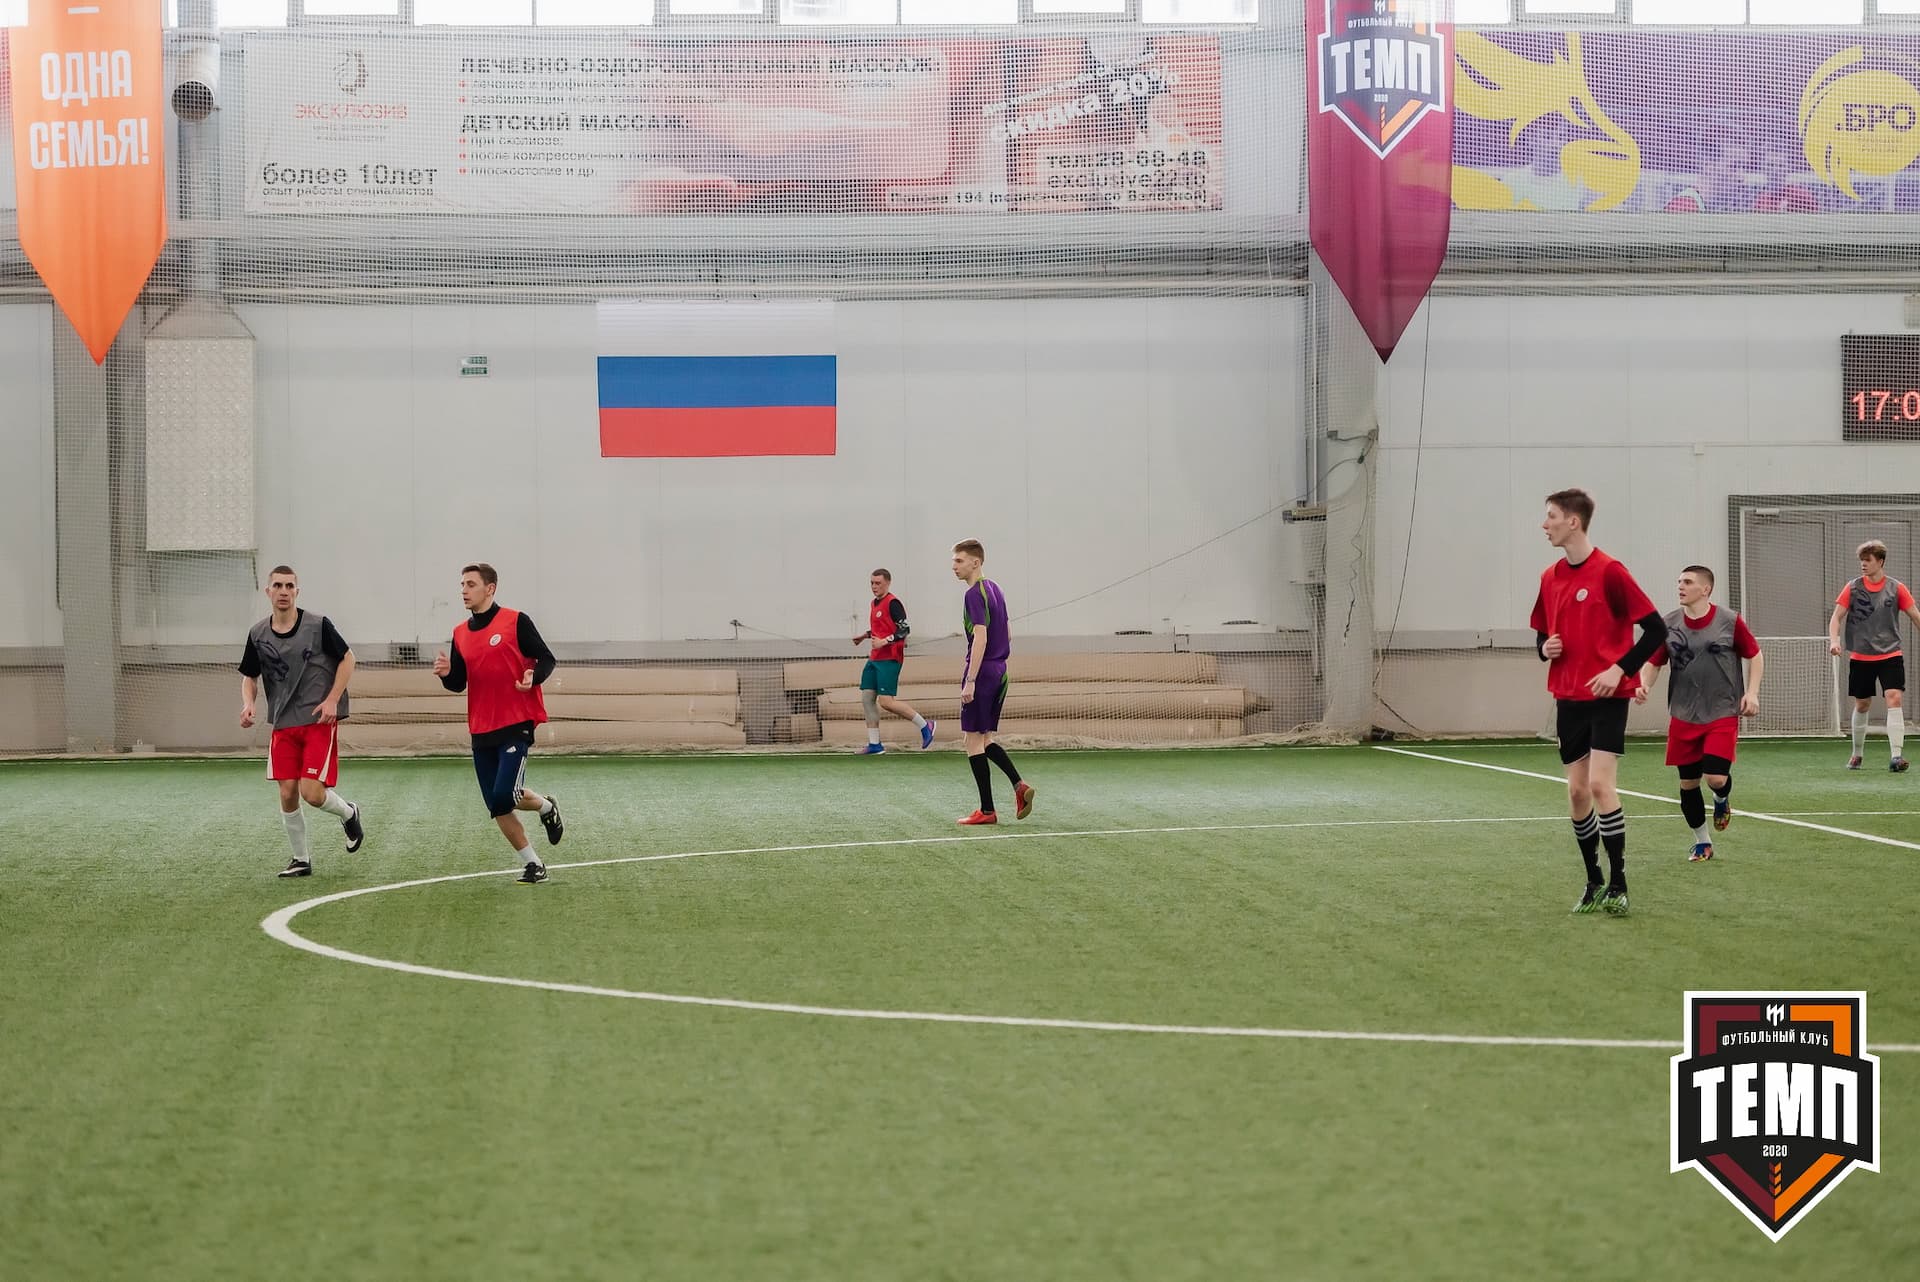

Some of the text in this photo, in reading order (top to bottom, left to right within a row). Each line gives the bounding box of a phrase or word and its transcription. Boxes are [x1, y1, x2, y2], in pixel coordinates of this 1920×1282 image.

[40, 49, 132, 108] ОДНА
[1110, 63, 1181, 104] 20%
[1331, 38, 1431, 95] ТЕМП
[294, 104, 408, 120] ЭКСКЛЮЗИВ
[462, 112, 570, 133] ДЕТСКИЙ
[30, 117, 150, 170] СЕМЬЯ!
[262, 162, 347, 185] более
